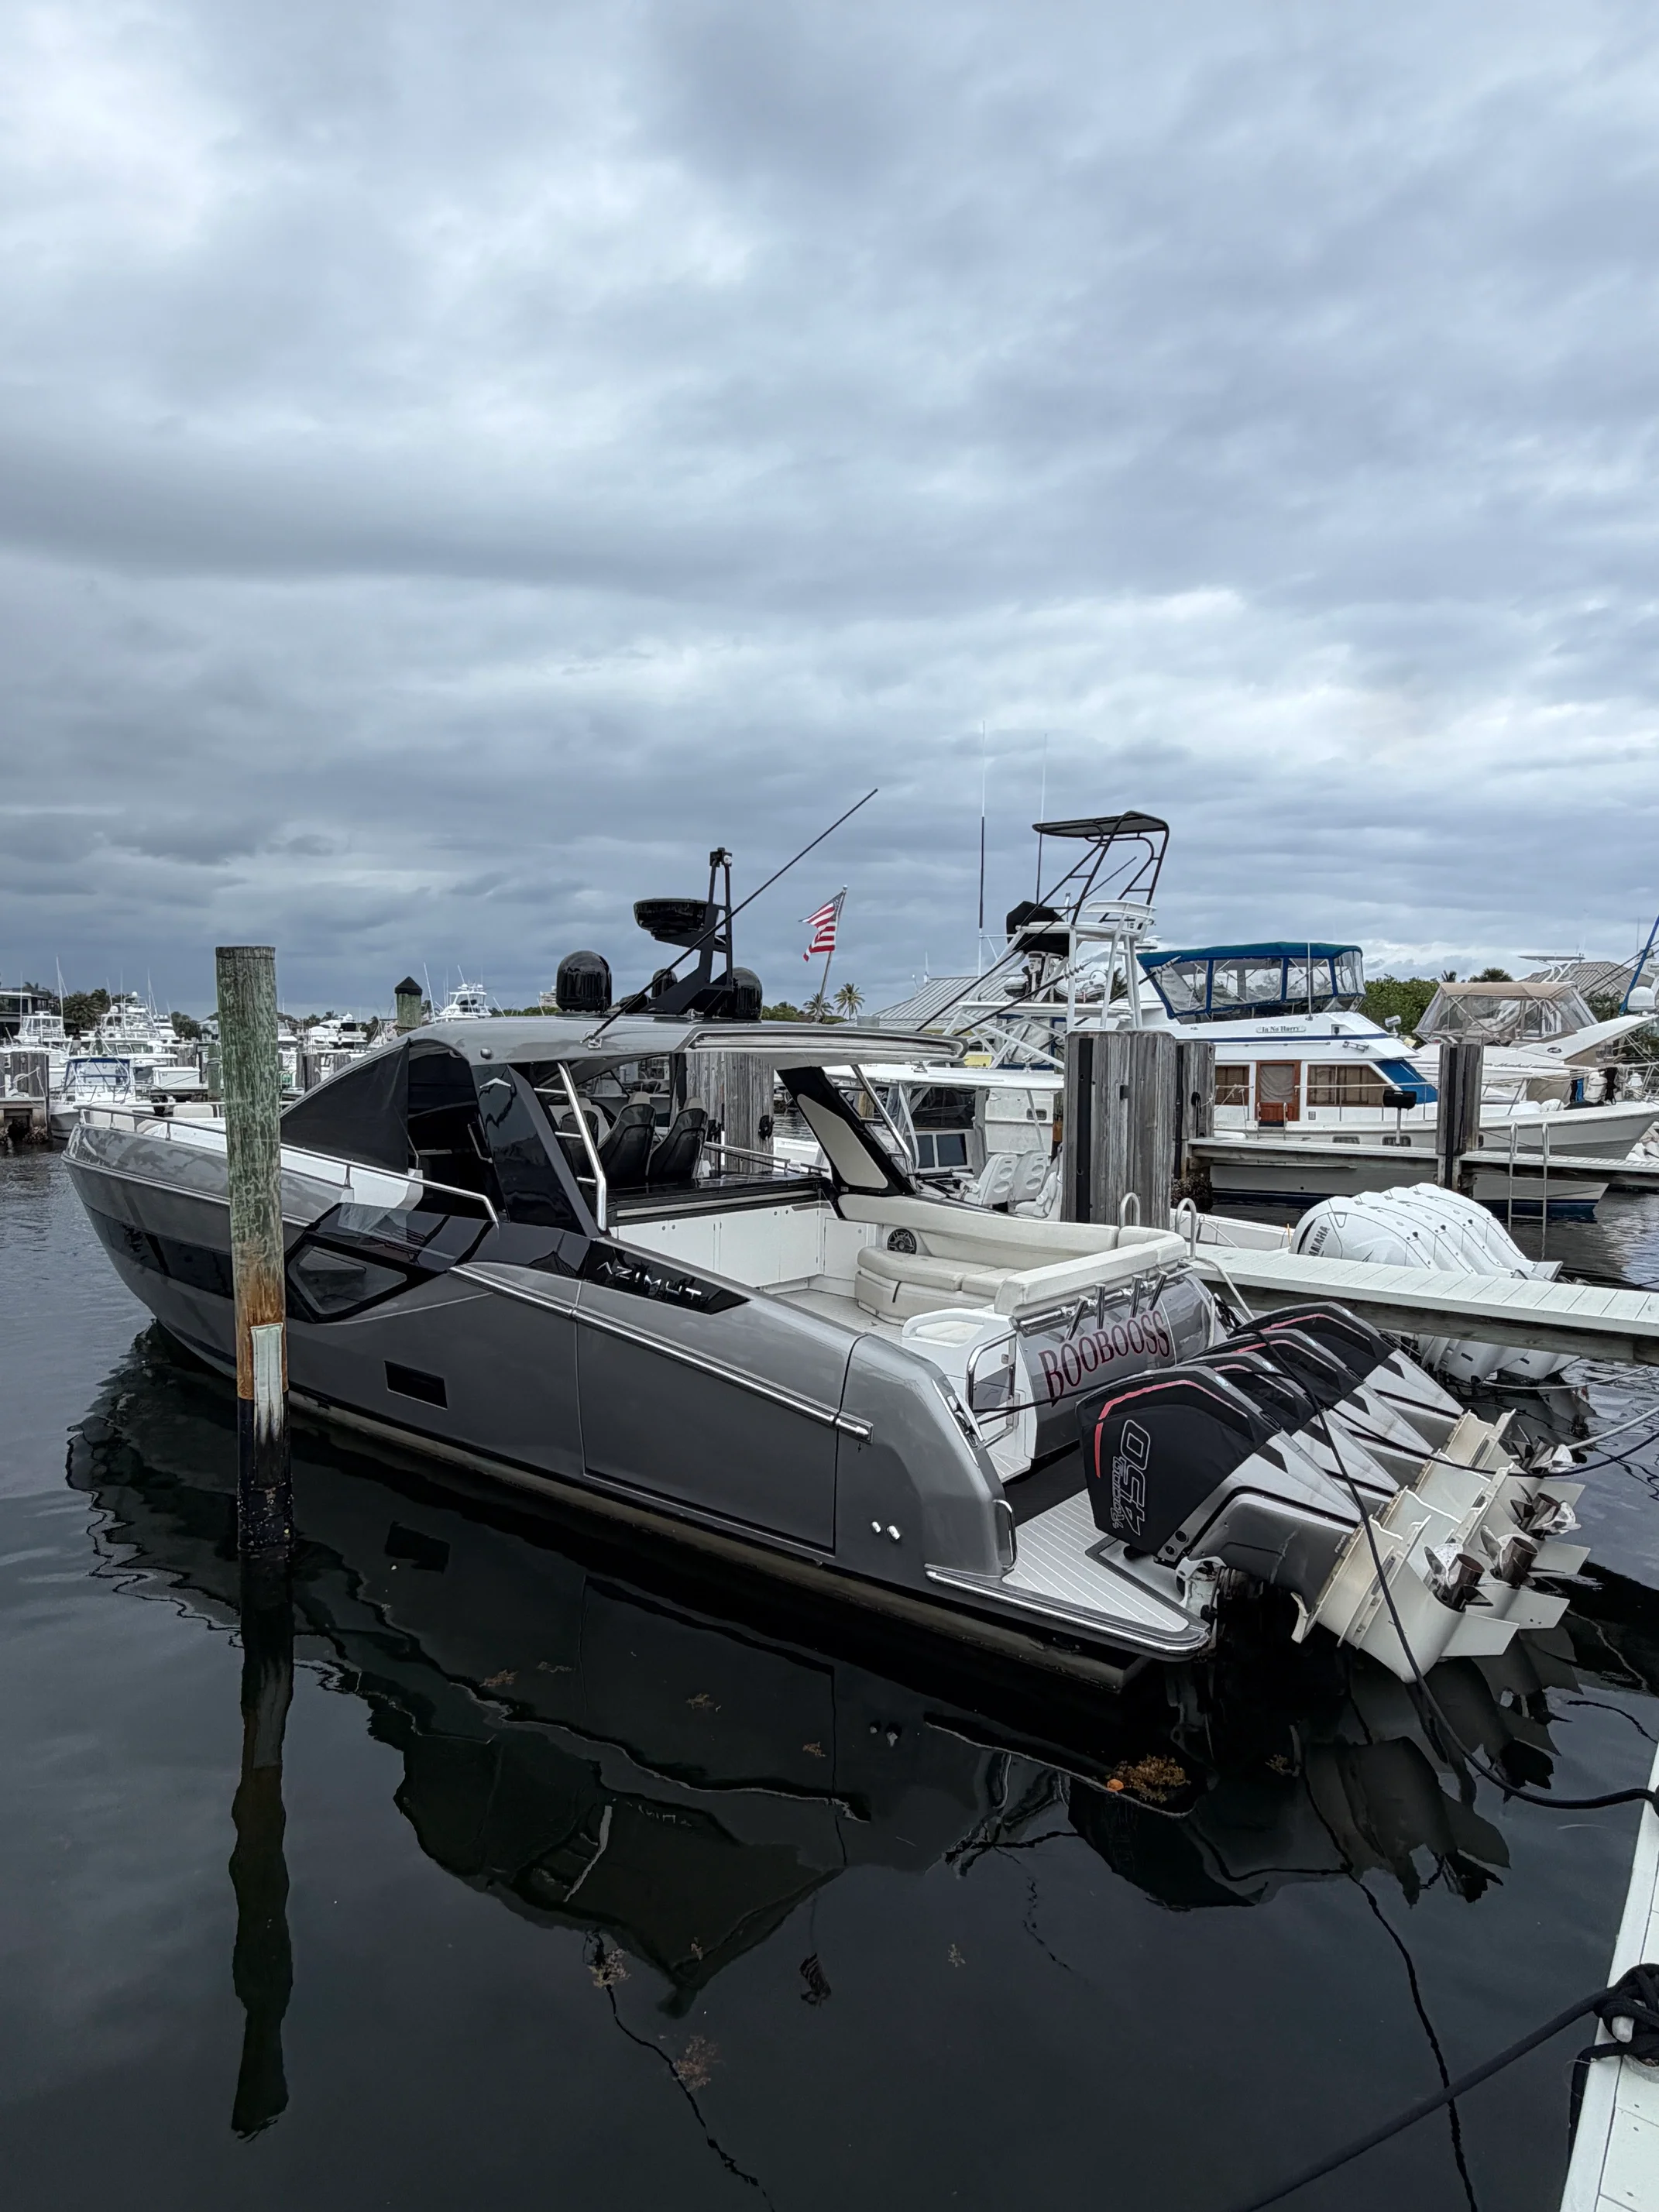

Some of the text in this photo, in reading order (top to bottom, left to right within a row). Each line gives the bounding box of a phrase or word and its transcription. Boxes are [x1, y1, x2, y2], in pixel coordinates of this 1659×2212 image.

[1309, 1226, 1329, 1256] AMAHA
[1038, 1310, 1170, 1408] BOOBOOSS
[1119, 1419, 1151, 1536] 450
